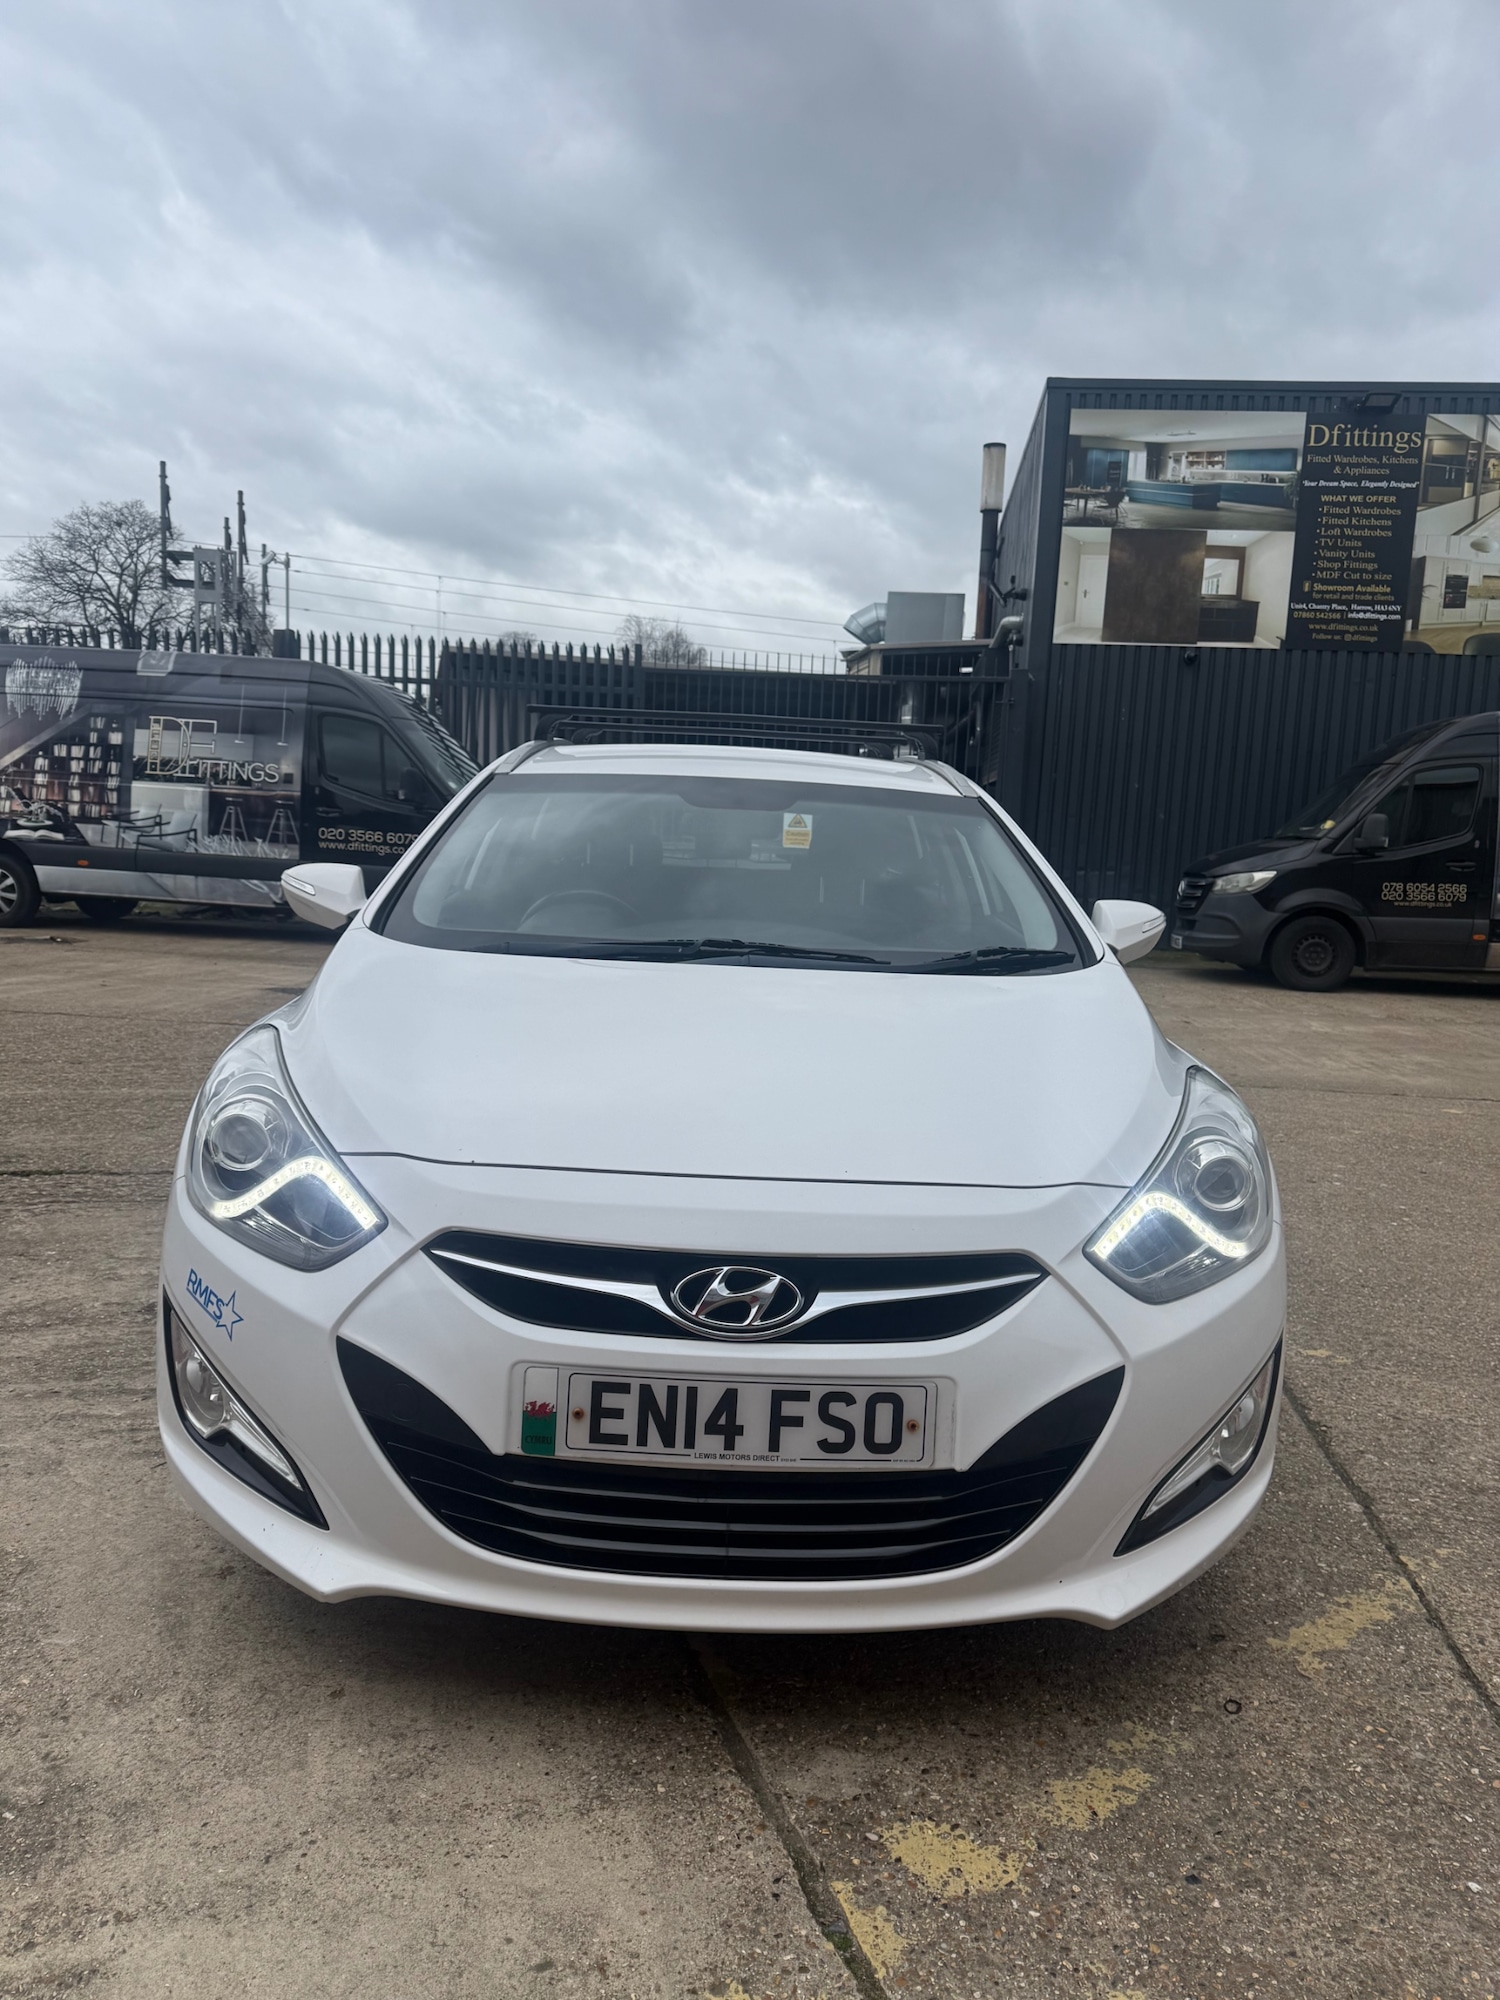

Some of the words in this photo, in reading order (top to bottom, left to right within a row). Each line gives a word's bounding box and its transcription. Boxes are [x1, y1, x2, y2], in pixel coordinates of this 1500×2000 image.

[1307, 424, 1422, 453] Dfittings
[1307, 454, 1331, 463] Fitted
[1334, 455, 1380, 464] Wardrobes,
[1382, 456, 1419, 464] Kitchens
[1333, 466, 1341, 474] &
[1343, 466, 1390, 476] Appliances
[1361, 480, 1389, 489] Elegantly
[1349, 495, 1364, 503] WE
[1366, 495, 1397, 503] OFFER
[1323, 505, 1350, 514] Fitted
[1353, 506, 1401, 515] Wardrobes
[1322, 516, 1349, 525] Fitted
[1351, 517, 1392, 526] Kitchens
[1321, 527, 1341, 536] Loft
[1343, 528, 1392, 537] Wardrobes
[1320, 538, 1334, 546] TV
[1337, 538, 1362, 547] Units
[1319, 549, 1348, 560] Vanity
[1351, 550, 1376, 558] Units
[1317, 560, 1341, 570] Shop
[1343, 560, 1378, 571] Fittings
[1316, 571, 1341, 579] MDF
[1343, 571, 1360, 580] Cut
[1362, 572, 1372, 580] to
[1374, 572, 1392, 580] size
[1313, 583, 1354, 592] Showroom
[1356, 584, 1391, 593] Available
[1323, 592, 1340, 600] retail
[1355, 593, 1373, 601] trade
[1347, 612, 1401, 621] info@dfittings.com
[1308, 623, 1378, 632] www.dfittings.co.uk
[318, 827, 345, 840] 020
[348, 829, 384, 843] 3566
[1382, 882, 1404, 892] 078
[1406, 883, 1435, 893] 6054
[1437, 883, 1468, 893] 2566
[1381, 891, 1404, 901] 020
[1405, 892, 1436, 901] 3566
[1438, 892, 1467, 902] 6079
[187, 1268, 225, 1320] RMFS
[589, 1381, 744, 1451] EN14
[768, 1390, 904, 1455] FSO
[694, 1452, 718, 1460] LEWIS
[719, 1453, 751, 1461] MOTORS
[752, 1454, 781, 1462] DIRECT
